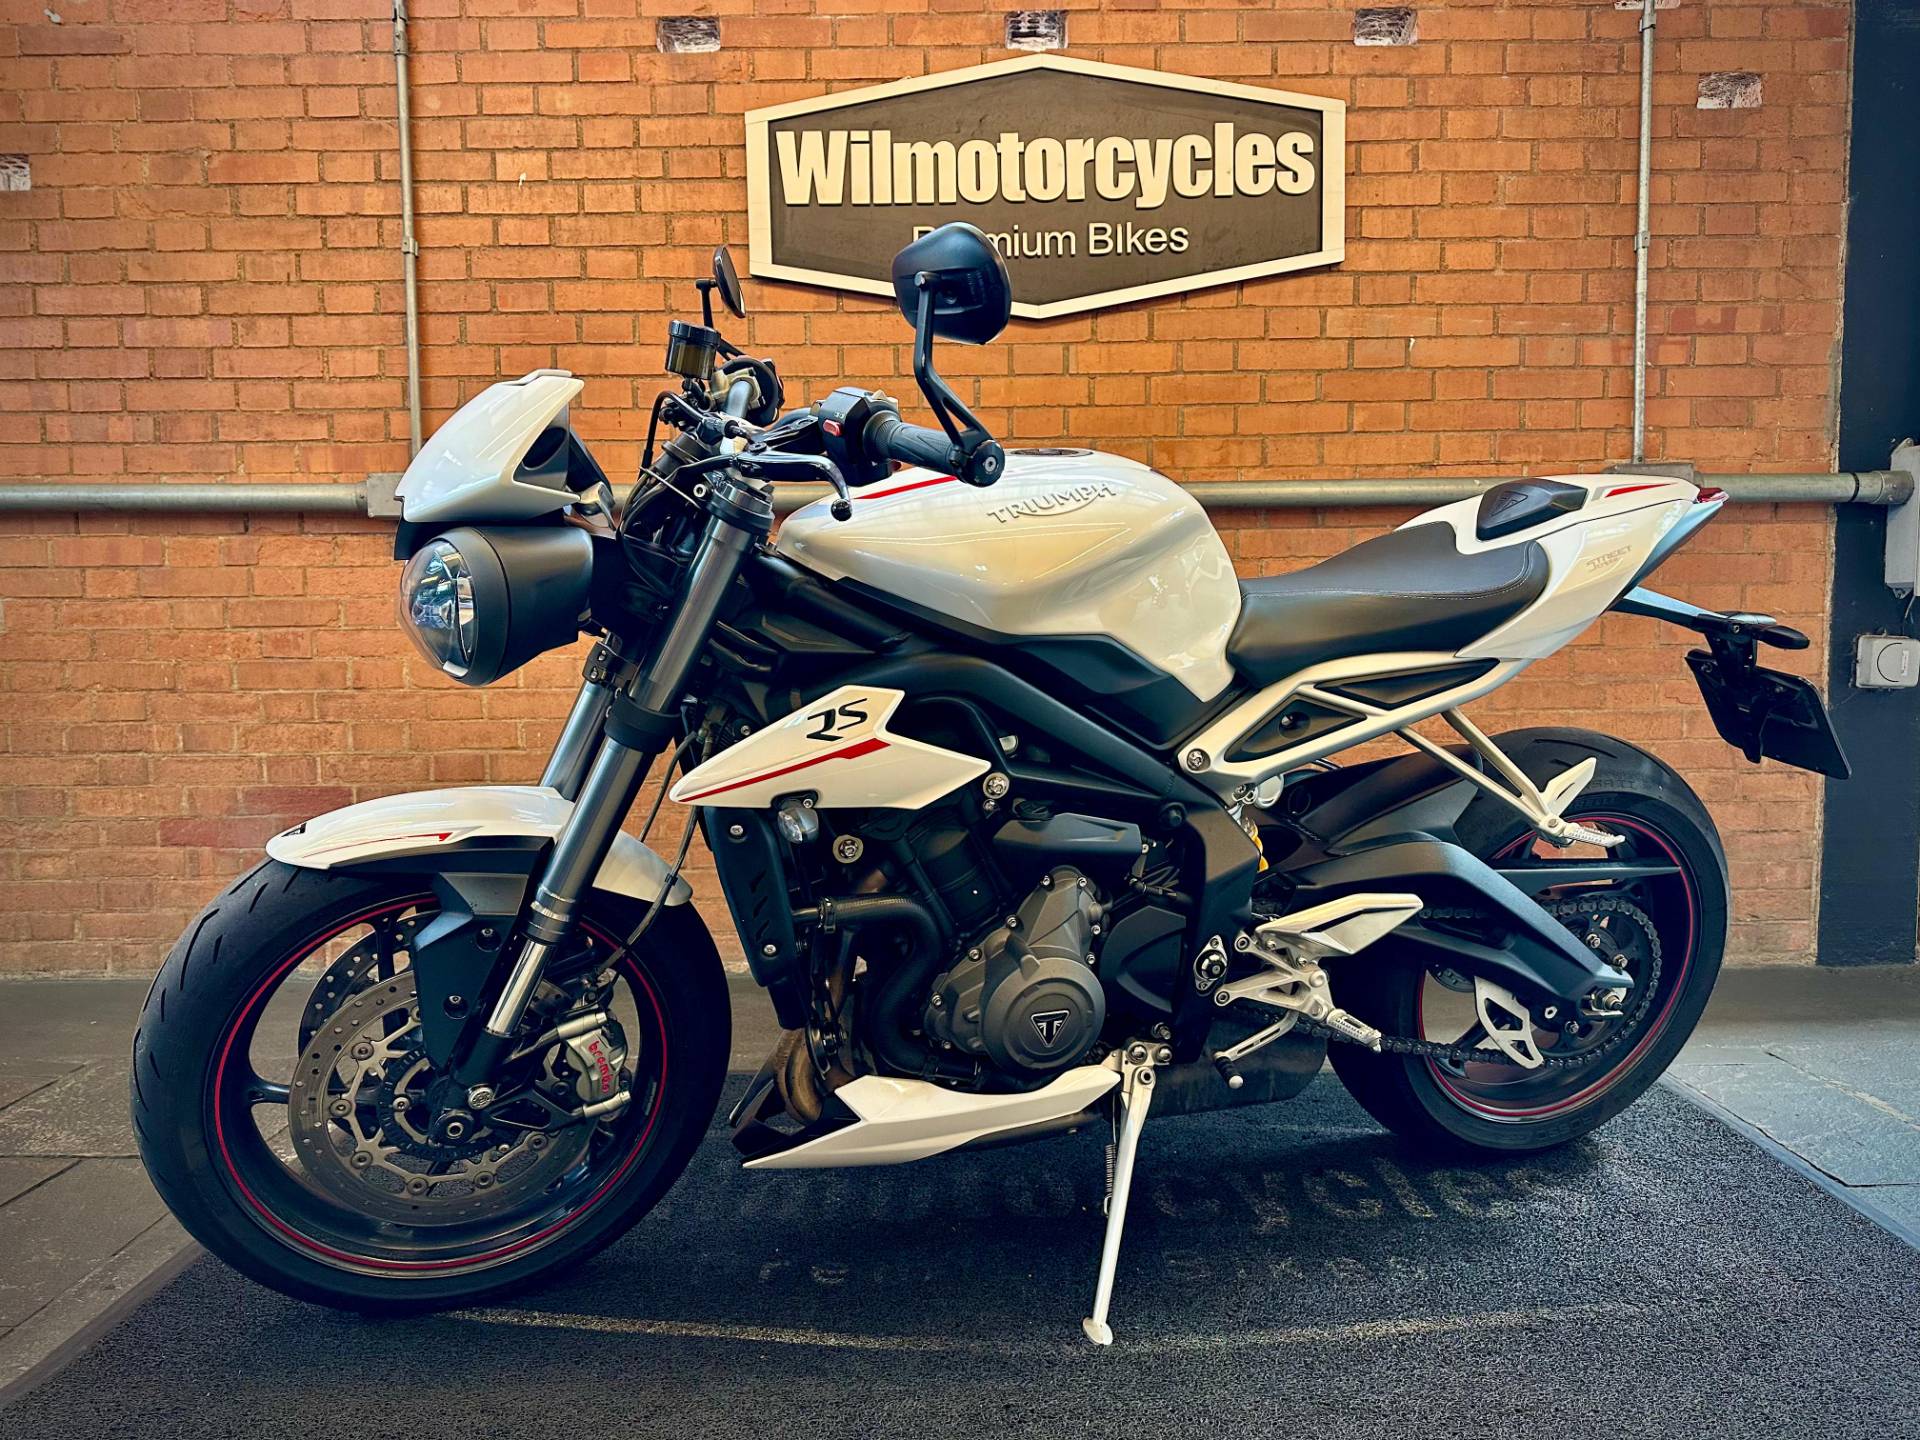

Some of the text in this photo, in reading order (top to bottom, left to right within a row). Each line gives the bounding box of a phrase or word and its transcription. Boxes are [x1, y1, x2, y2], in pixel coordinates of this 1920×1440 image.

[776, 122, 1315, 208] Wilmotorcycles
[912, 225, 1076, 257] mium
[986, 483, 1117, 523] TRIUMPH
[806, 697, 868, 741] RS
[588, 1040, 613, 1093] brembo
